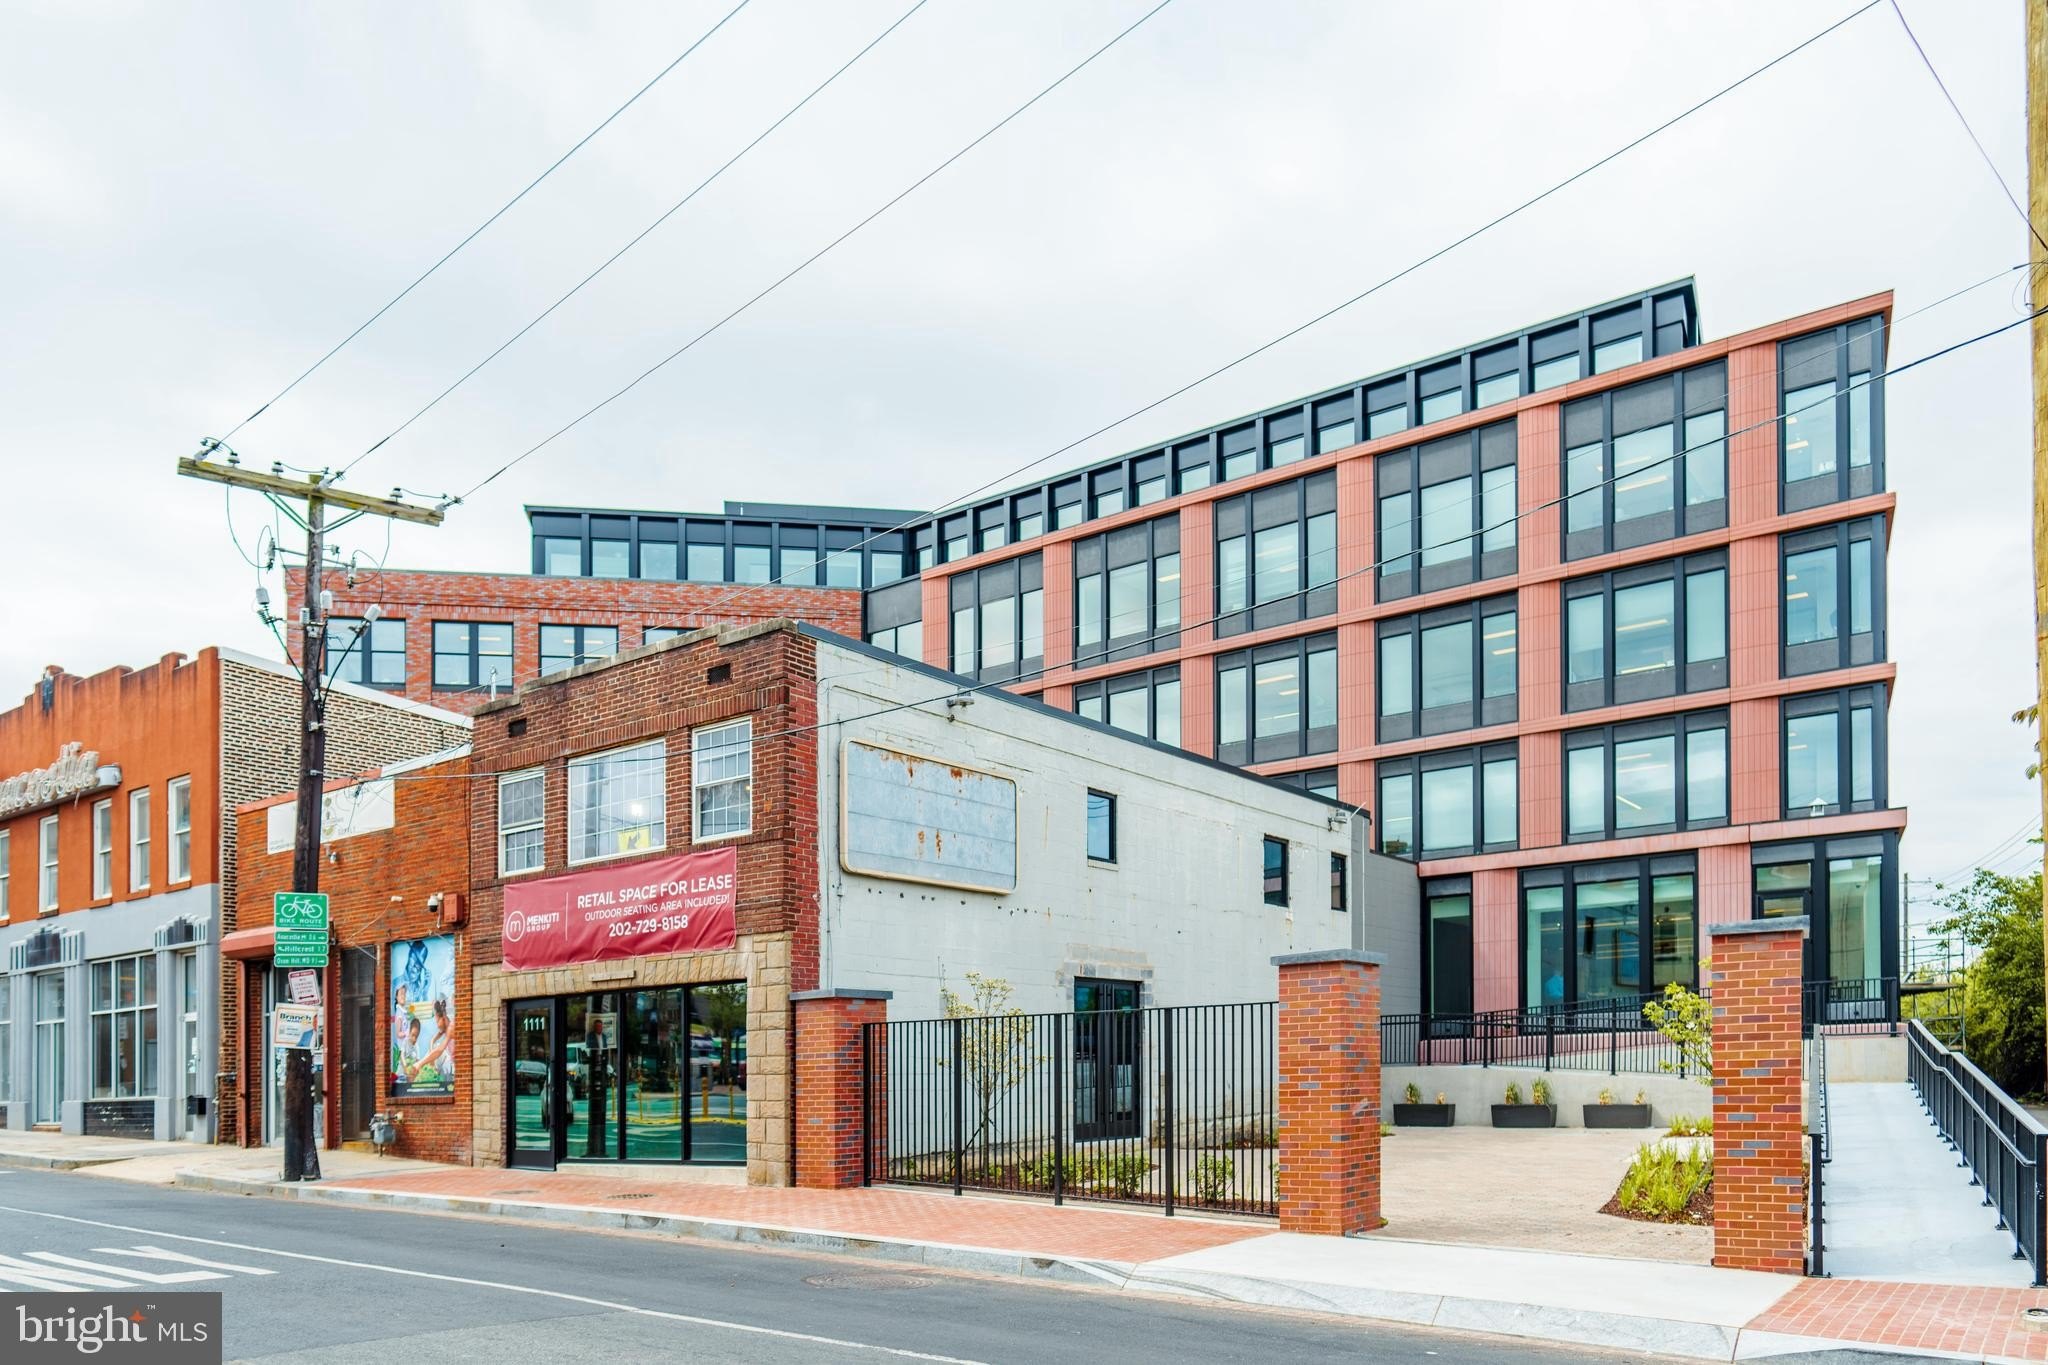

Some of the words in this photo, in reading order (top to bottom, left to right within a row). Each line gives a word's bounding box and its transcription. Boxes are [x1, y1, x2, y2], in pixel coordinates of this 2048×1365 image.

[577, 890, 616, 910] RETAIL
[619, 885, 657, 903] SPACE
[660, 881, 688, 898] FOR
[690, 874, 733, 893] LEASE
[584, 906, 623, 922] OUTDOOR
[623, 902, 658, 918] SEATING
[660, 899, 682, 912] AREA
[685, 893, 731, 908] INCLUDED!
[526, 912, 560, 926] MENKITI
[608, 914, 688, 938] 202-729-8158
[526, 923, 551, 933] GROUP
[280, 1012, 312, 1021] Branch
[523, 1016, 545, 1032] 1111
